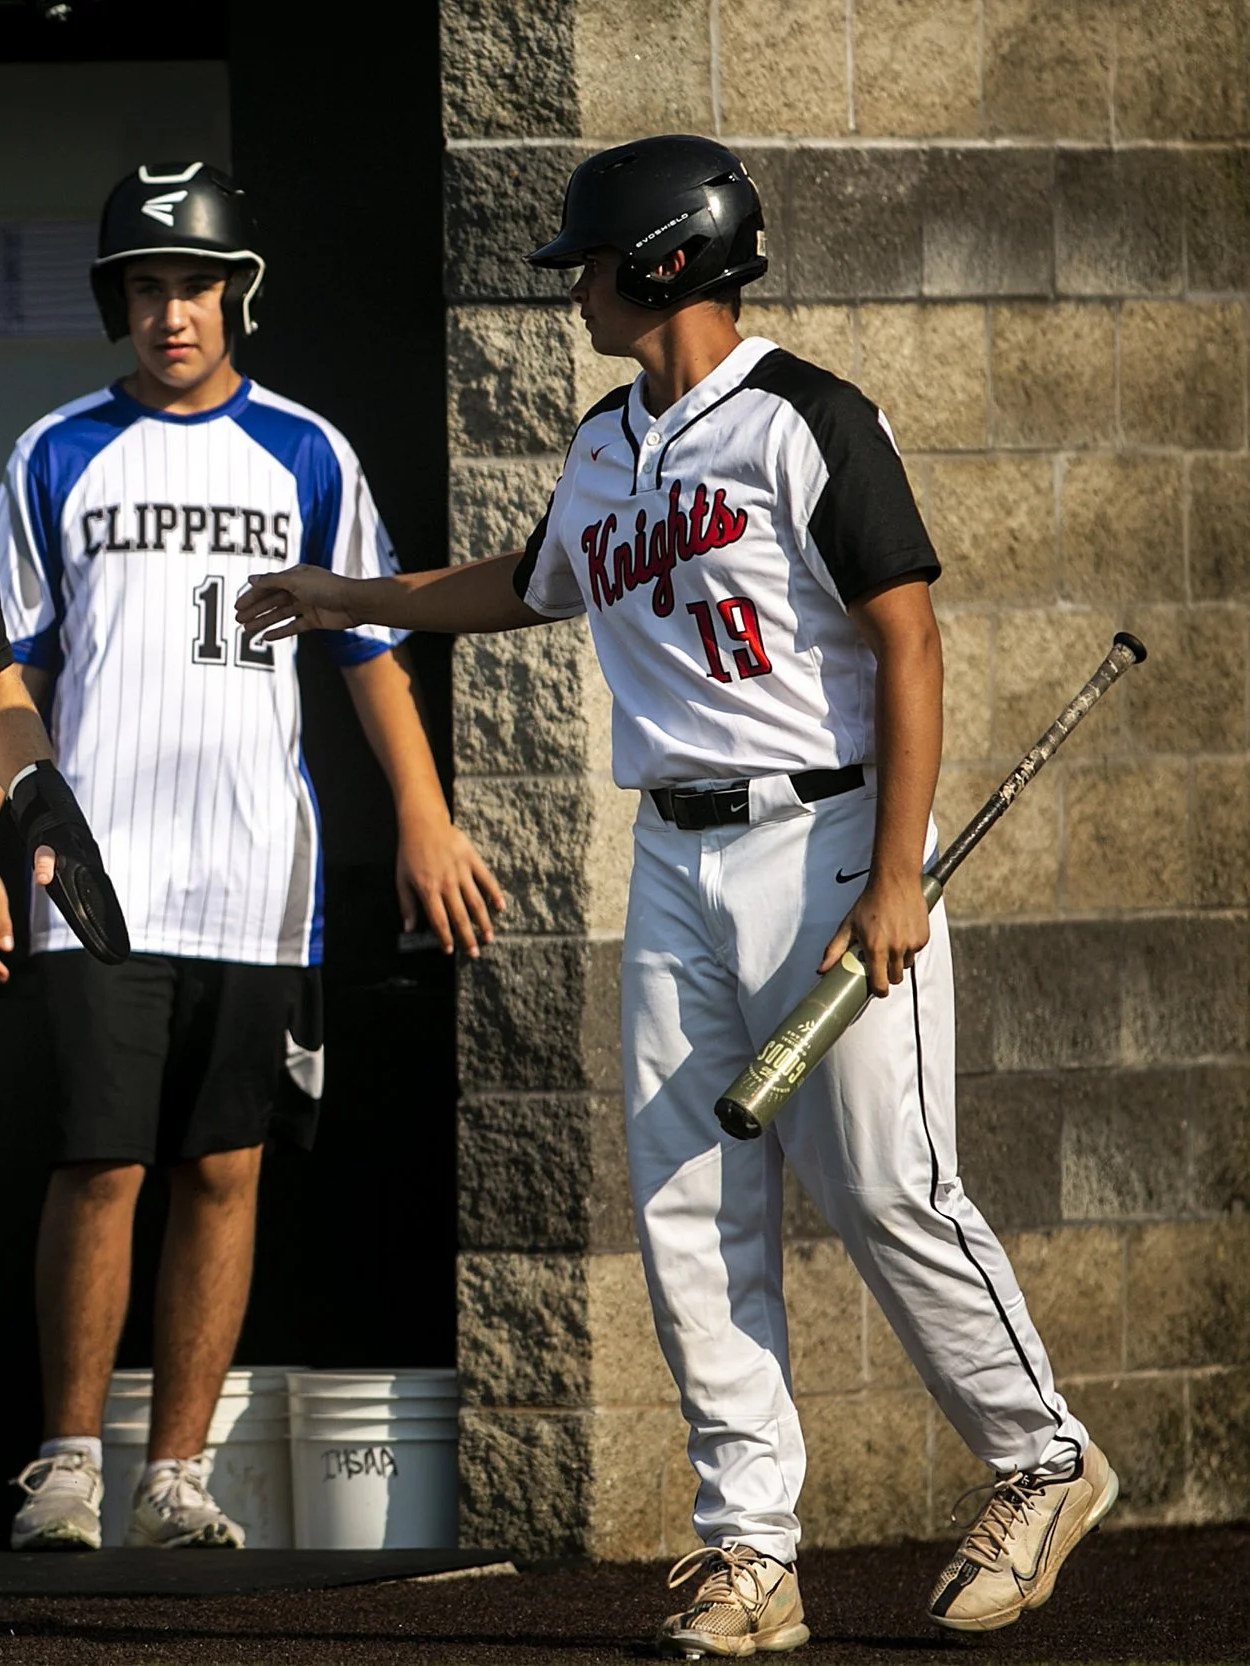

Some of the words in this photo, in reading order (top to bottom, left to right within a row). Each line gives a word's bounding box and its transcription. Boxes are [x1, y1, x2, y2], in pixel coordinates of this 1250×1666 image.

[83, 503, 291, 560] CLIPPERS
[582, 480, 748, 617] Knights
[686, 597, 772, 683] 19
[756, 1040, 807, 1084] GOODS
